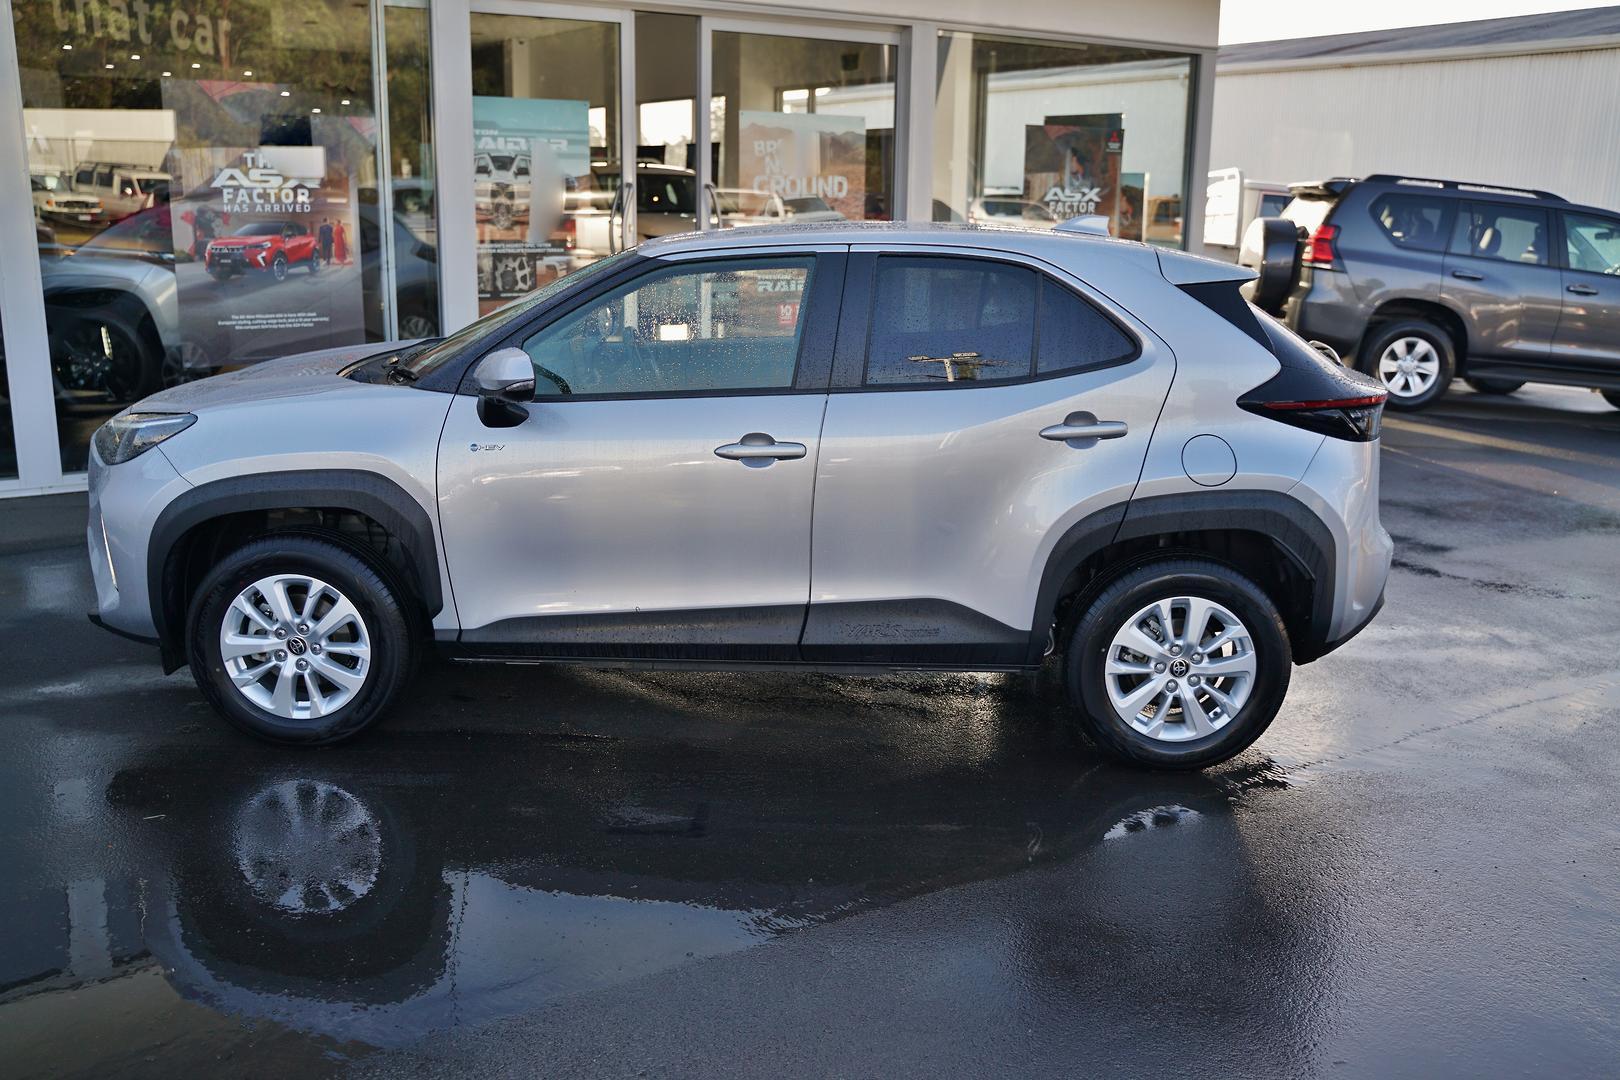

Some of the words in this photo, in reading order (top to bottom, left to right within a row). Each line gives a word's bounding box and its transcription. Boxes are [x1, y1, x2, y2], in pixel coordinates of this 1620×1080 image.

[170, 9, 232, 58] car
[752, 175, 849, 199] GROUND
[222, 188, 311, 204] FACTOR
[223, 204, 249, 214] HAS
[255, 203, 312, 213] ARRIVED
[1048, 201, 1096, 215] FACTOR
